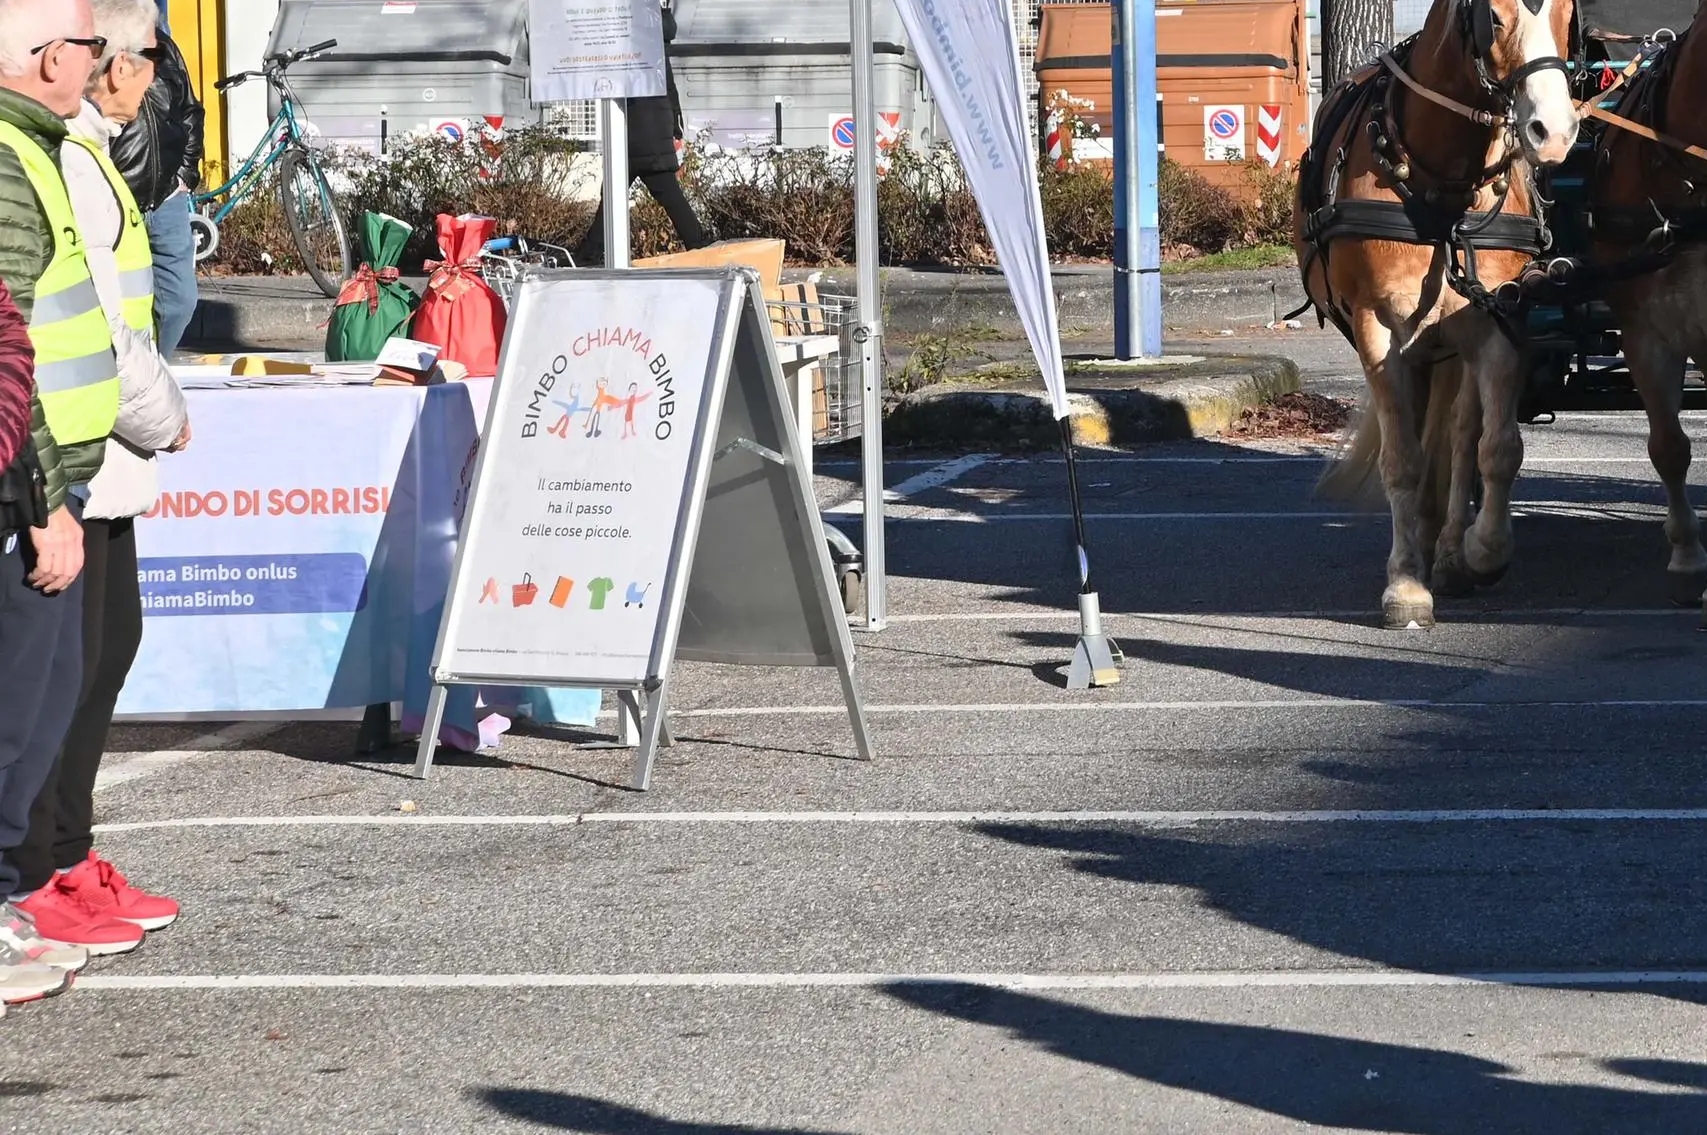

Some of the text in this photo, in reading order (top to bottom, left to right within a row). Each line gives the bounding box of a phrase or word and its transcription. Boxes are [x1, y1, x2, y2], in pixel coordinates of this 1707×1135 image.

[521, 326, 675, 441] BIMBO CHIAMA BIMBO
[537, 478, 632, 492] Il cambiamento
[233, 489, 260, 516] DI
[267, 486, 390, 517] SORRISI
[547, 501, 613, 517] ha il passo
[522, 524, 632, 540] delle cose piccole.
[137, 562, 297, 583] ama Bimbo onlus
